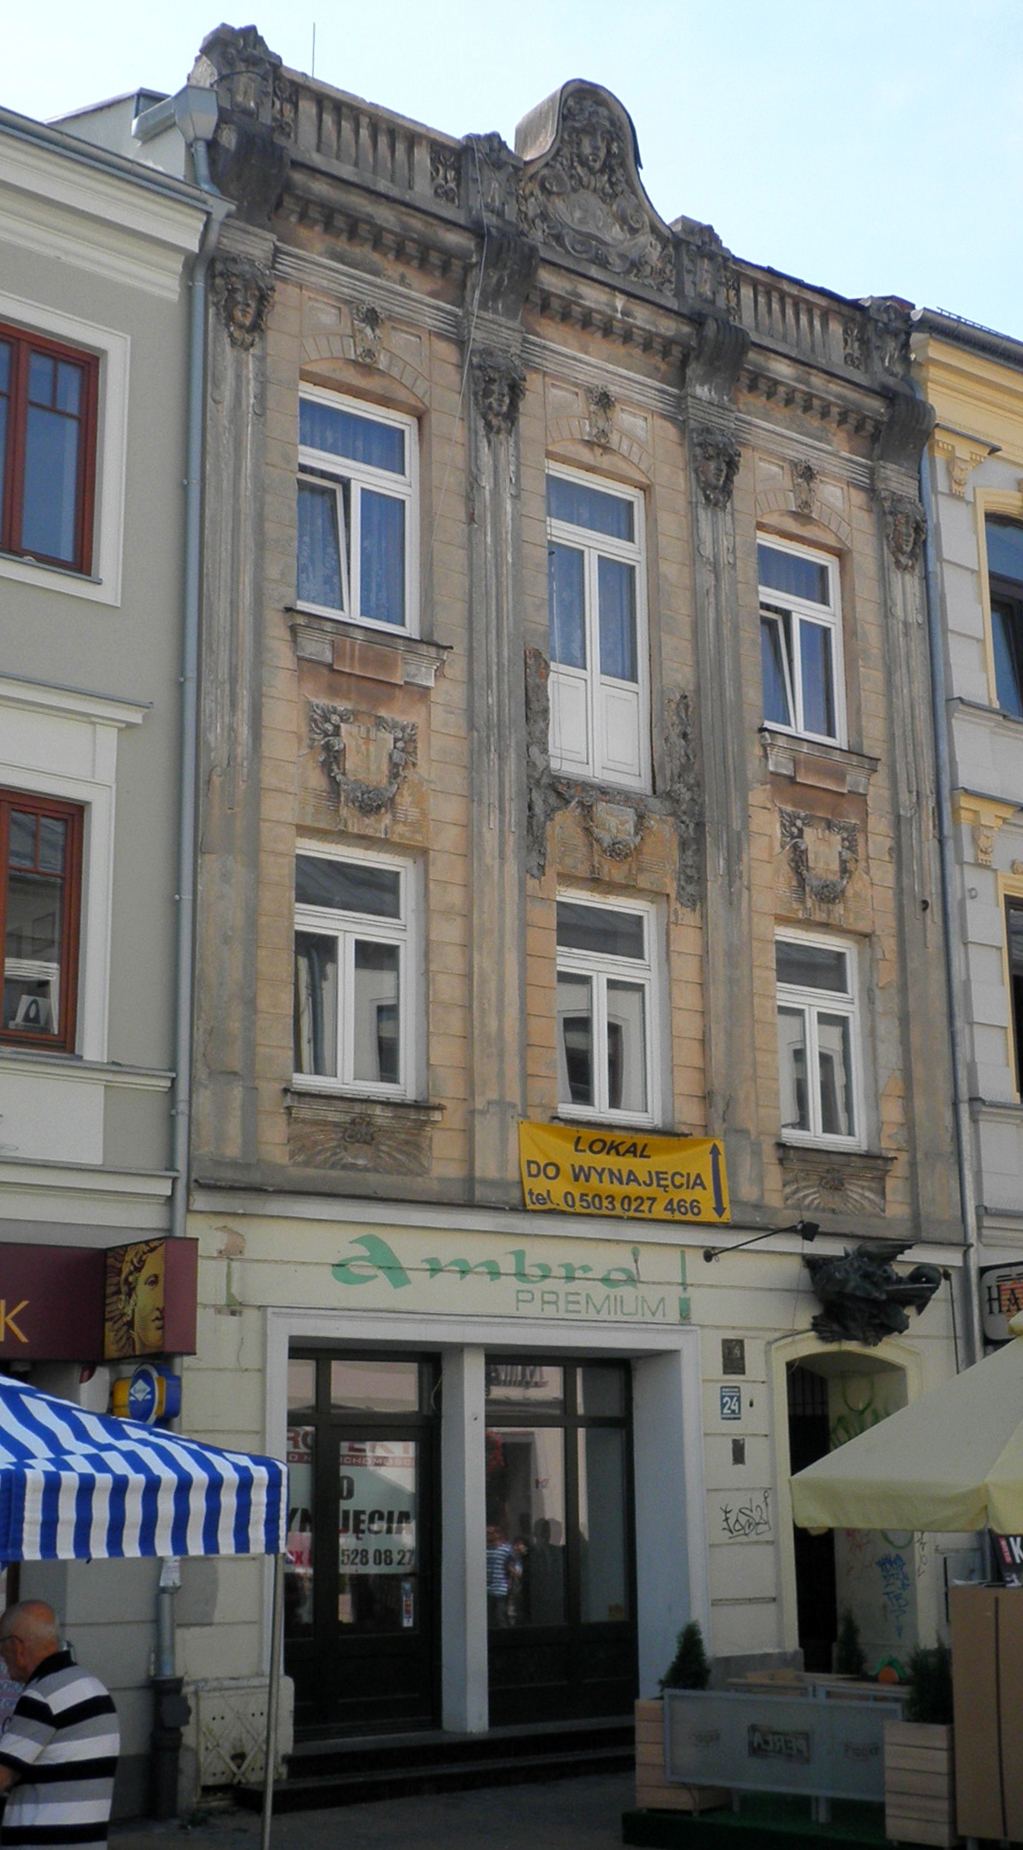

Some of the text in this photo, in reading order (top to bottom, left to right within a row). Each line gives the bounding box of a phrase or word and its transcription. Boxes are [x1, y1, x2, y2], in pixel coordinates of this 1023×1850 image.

[574, 1136, 652, 1159] LOKAL
[526, 1160, 707, 1193] DO WYNAJĘCIA
[528, 1188, 560, 1207] tel.
[663, 1197, 702, 1217] 466
[515, 1289, 666, 1318] PREMIUM
[723, 1397, 739, 1414] 24
[341, 1549, 369, 1565] 528
[373, 1549, 393, 1566] 08
